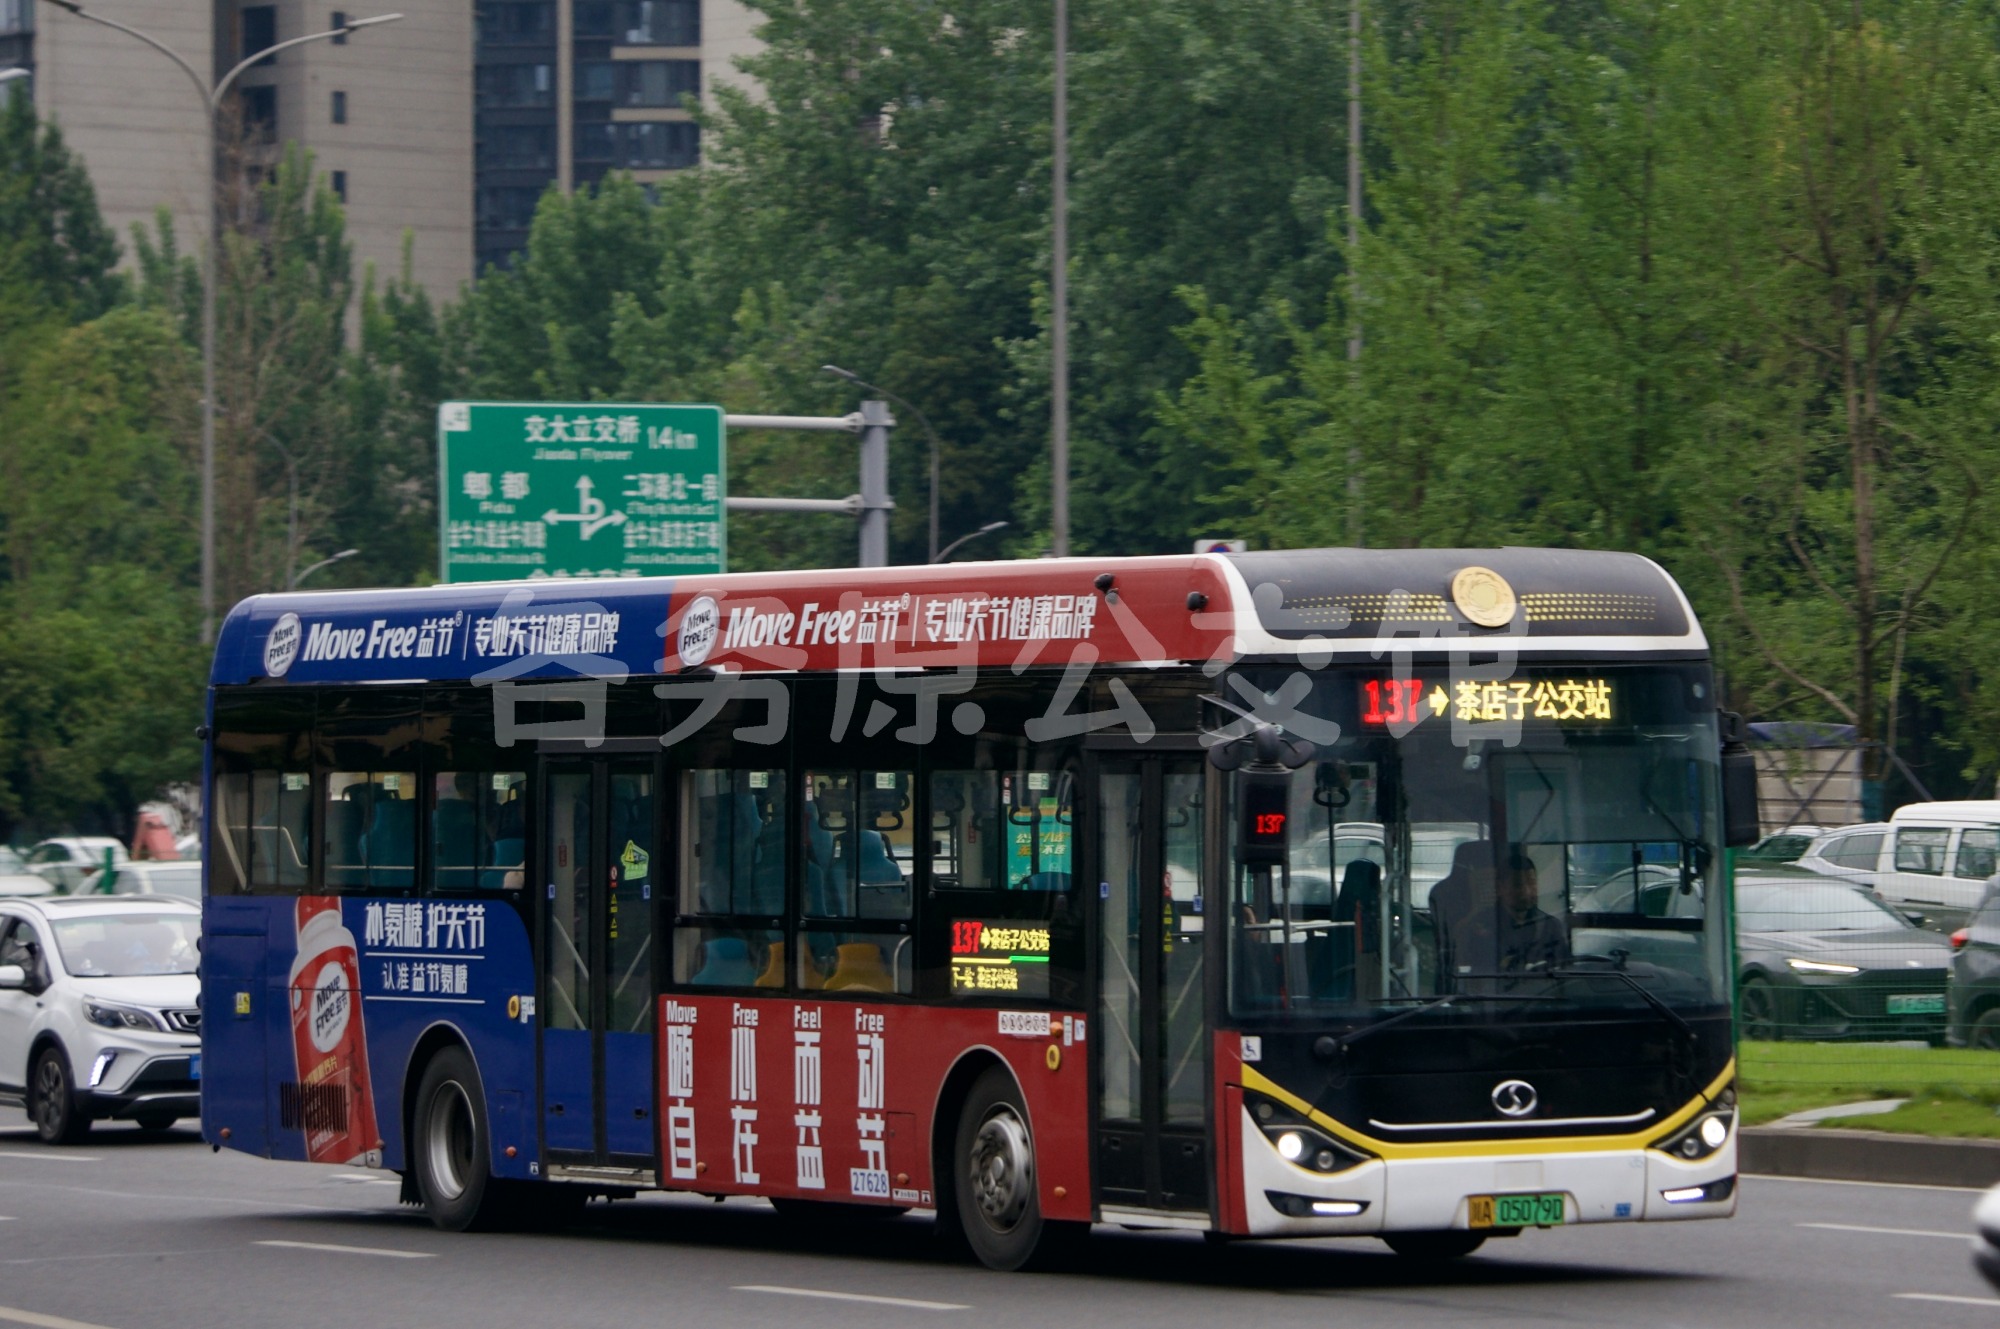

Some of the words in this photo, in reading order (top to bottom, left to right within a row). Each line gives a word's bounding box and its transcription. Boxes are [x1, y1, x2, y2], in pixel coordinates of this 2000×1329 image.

[524, 414, 641, 444] 交大立交桥
[302, 621, 361, 661] Move
[365, 618, 417, 660] Free
[473, 611, 620, 658] 专业关节健康品牌
[723, 606, 794, 649] Move
[796, 601, 856, 646] Free
[924, 593, 1098, 643] 专业关节健康品牌
[1363, 679, 1424, 724] 137
[1454, 679, 1612, 721] 茶店子公交站
[1255, 814, 1286, 834] 137
[952, 921, 982, 953] 137
[666, 1000, 697, 1024] Move
[733, 1003, 758, 1027] Free
[794, 1005, 822, 1029] Feel
[855, 1008, 884, 1032] Free
[852, 1172, 888, 1194] 27628
